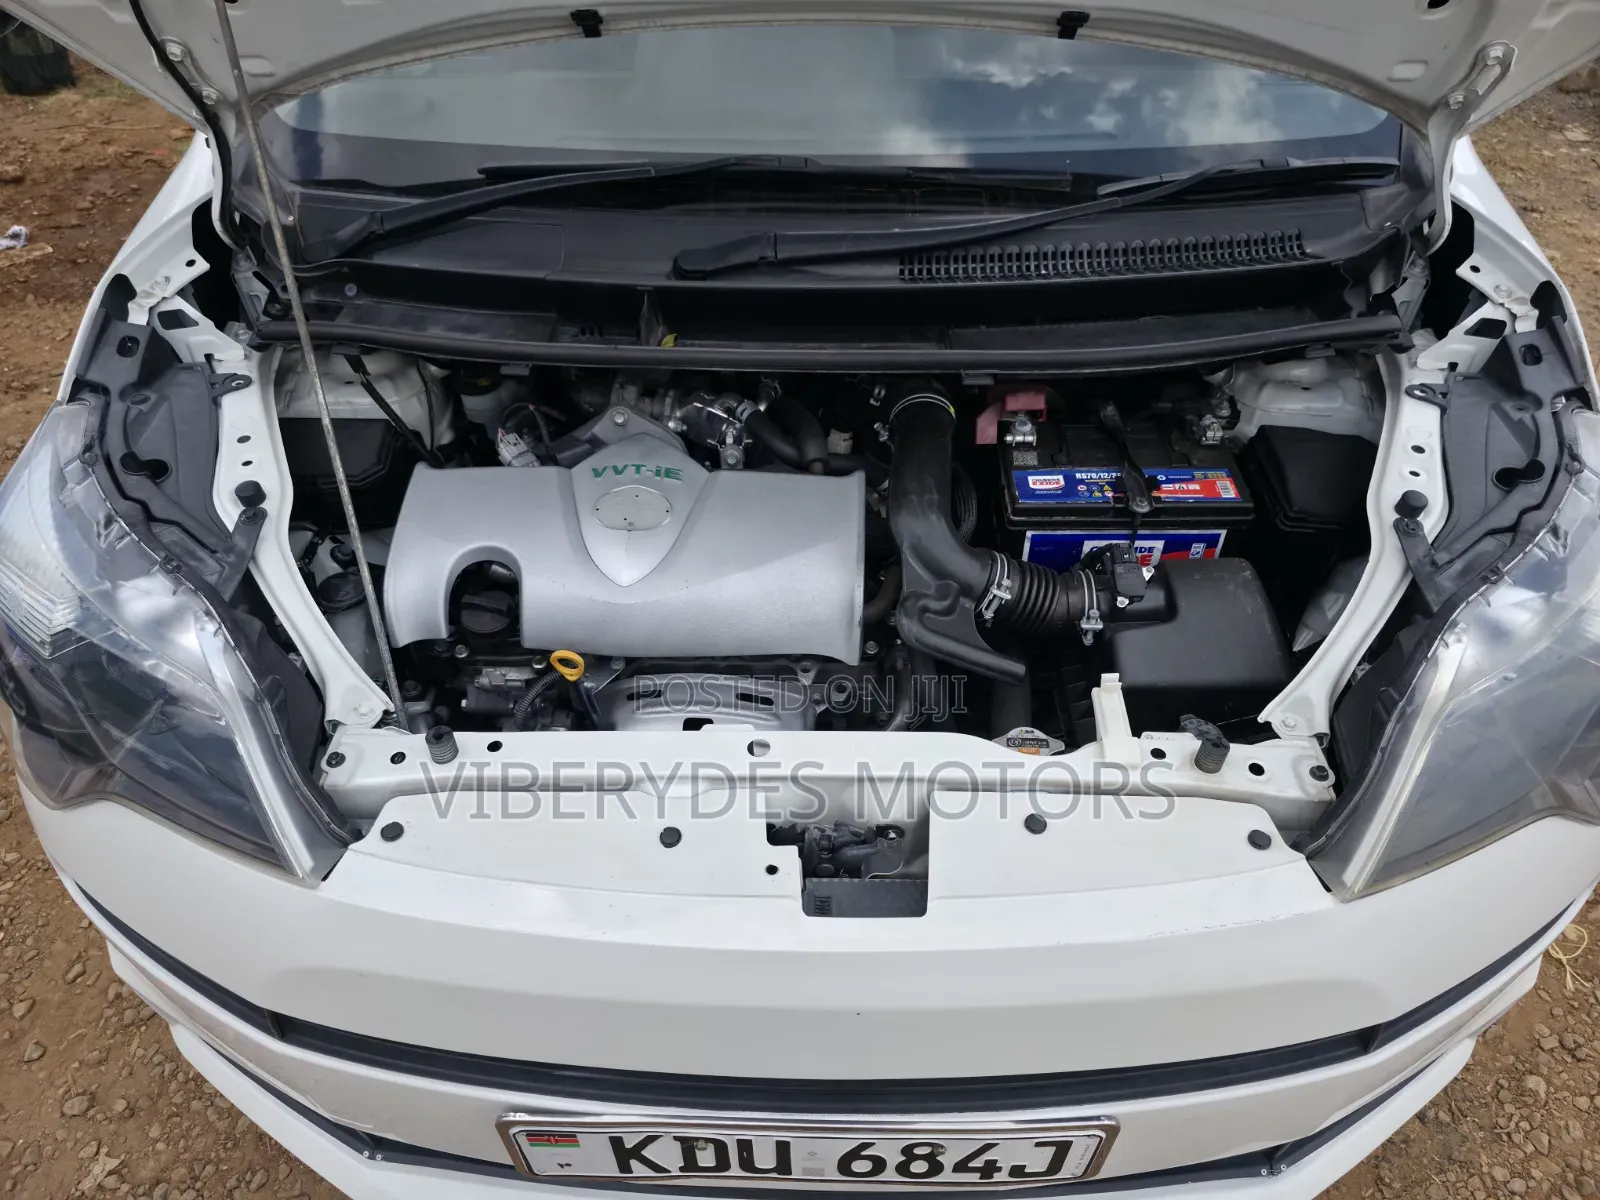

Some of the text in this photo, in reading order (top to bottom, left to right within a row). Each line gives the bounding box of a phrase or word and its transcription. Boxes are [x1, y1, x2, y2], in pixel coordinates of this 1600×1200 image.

[591, 463, 684, 482] VVT-iE
[608, 1134, 793, 1176] KDU
[836, 1140, 1075, 1181] 684J
